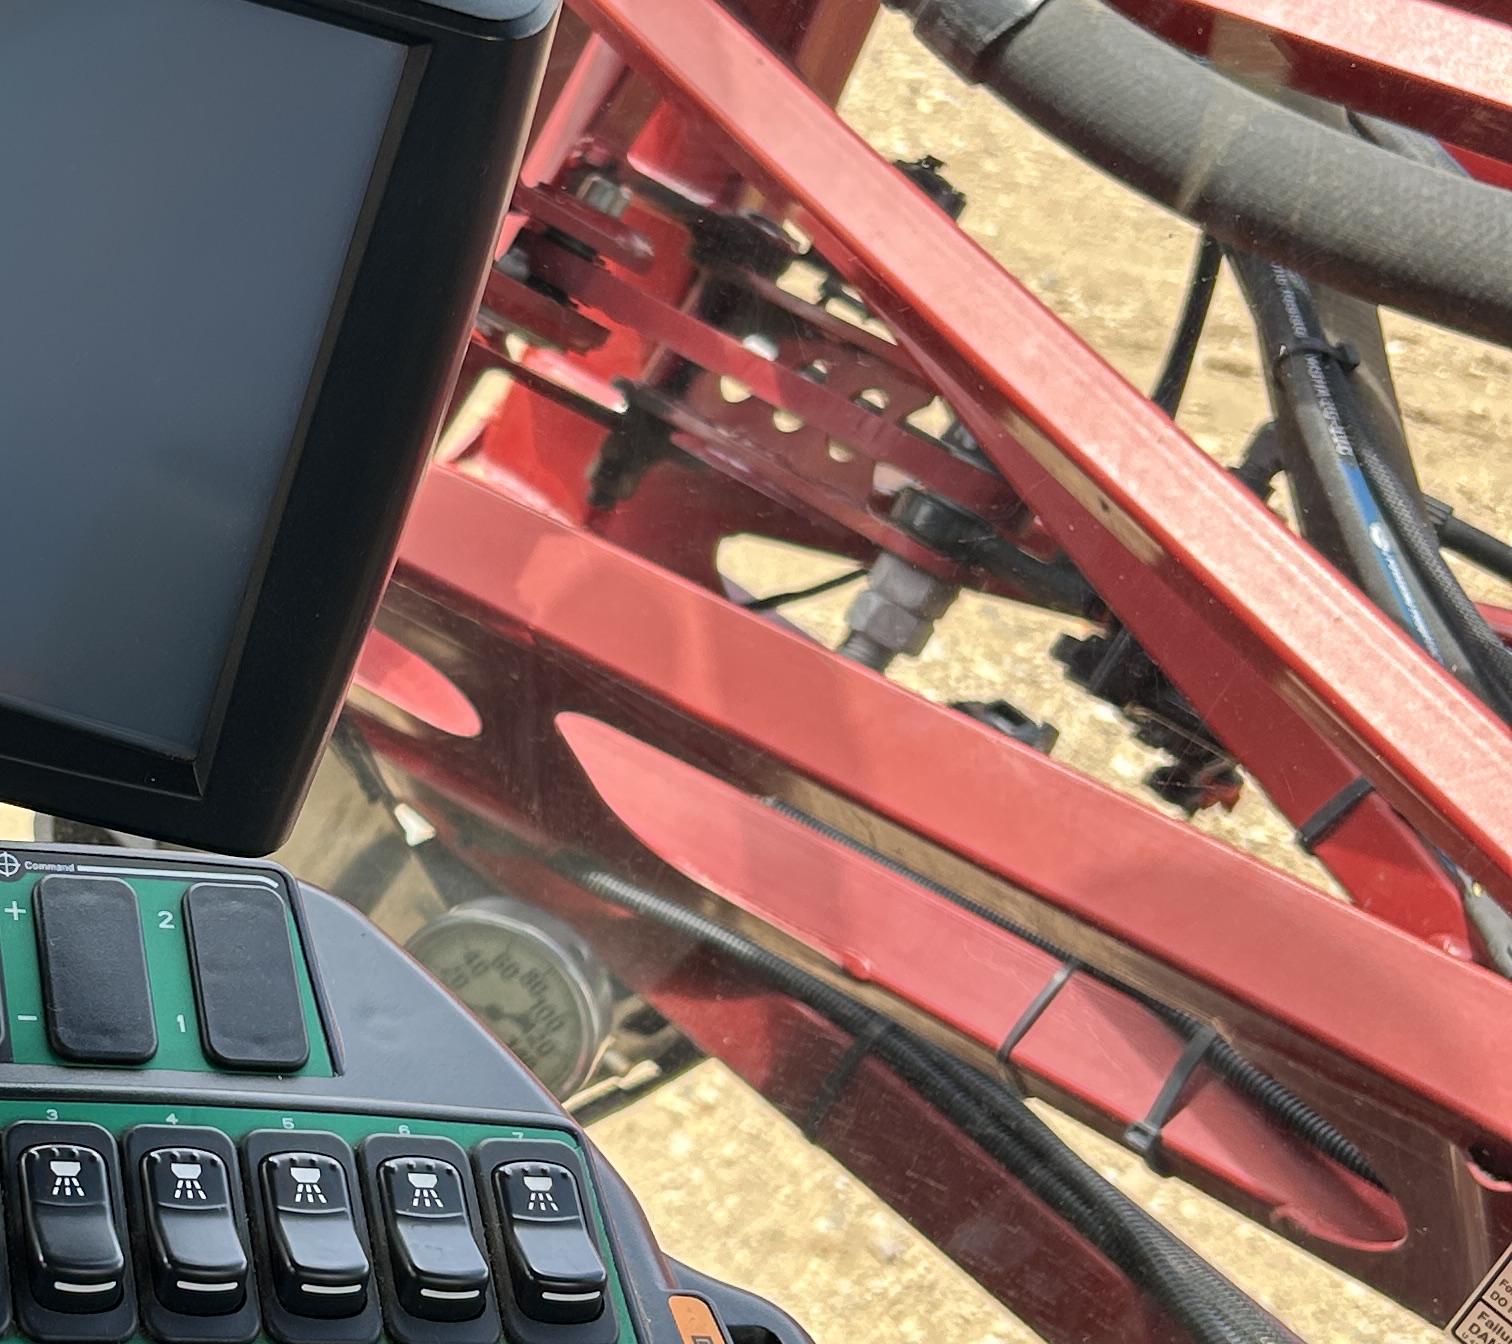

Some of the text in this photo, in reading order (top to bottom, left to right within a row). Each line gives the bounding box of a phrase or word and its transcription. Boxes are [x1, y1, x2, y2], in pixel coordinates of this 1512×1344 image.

[24, 860, 75, 873] Command
[157, 910, 175, 929] 2
[176, 1014, 186, 1033] 1
[46, 1109, 59, 1120] 3
[165, 1113, 179, 1125] 4
[281, 1117, 294, 1129] 5
[398, 1124, 410, 1135] 6
[1489, 1290, 1508, 1307] DO
